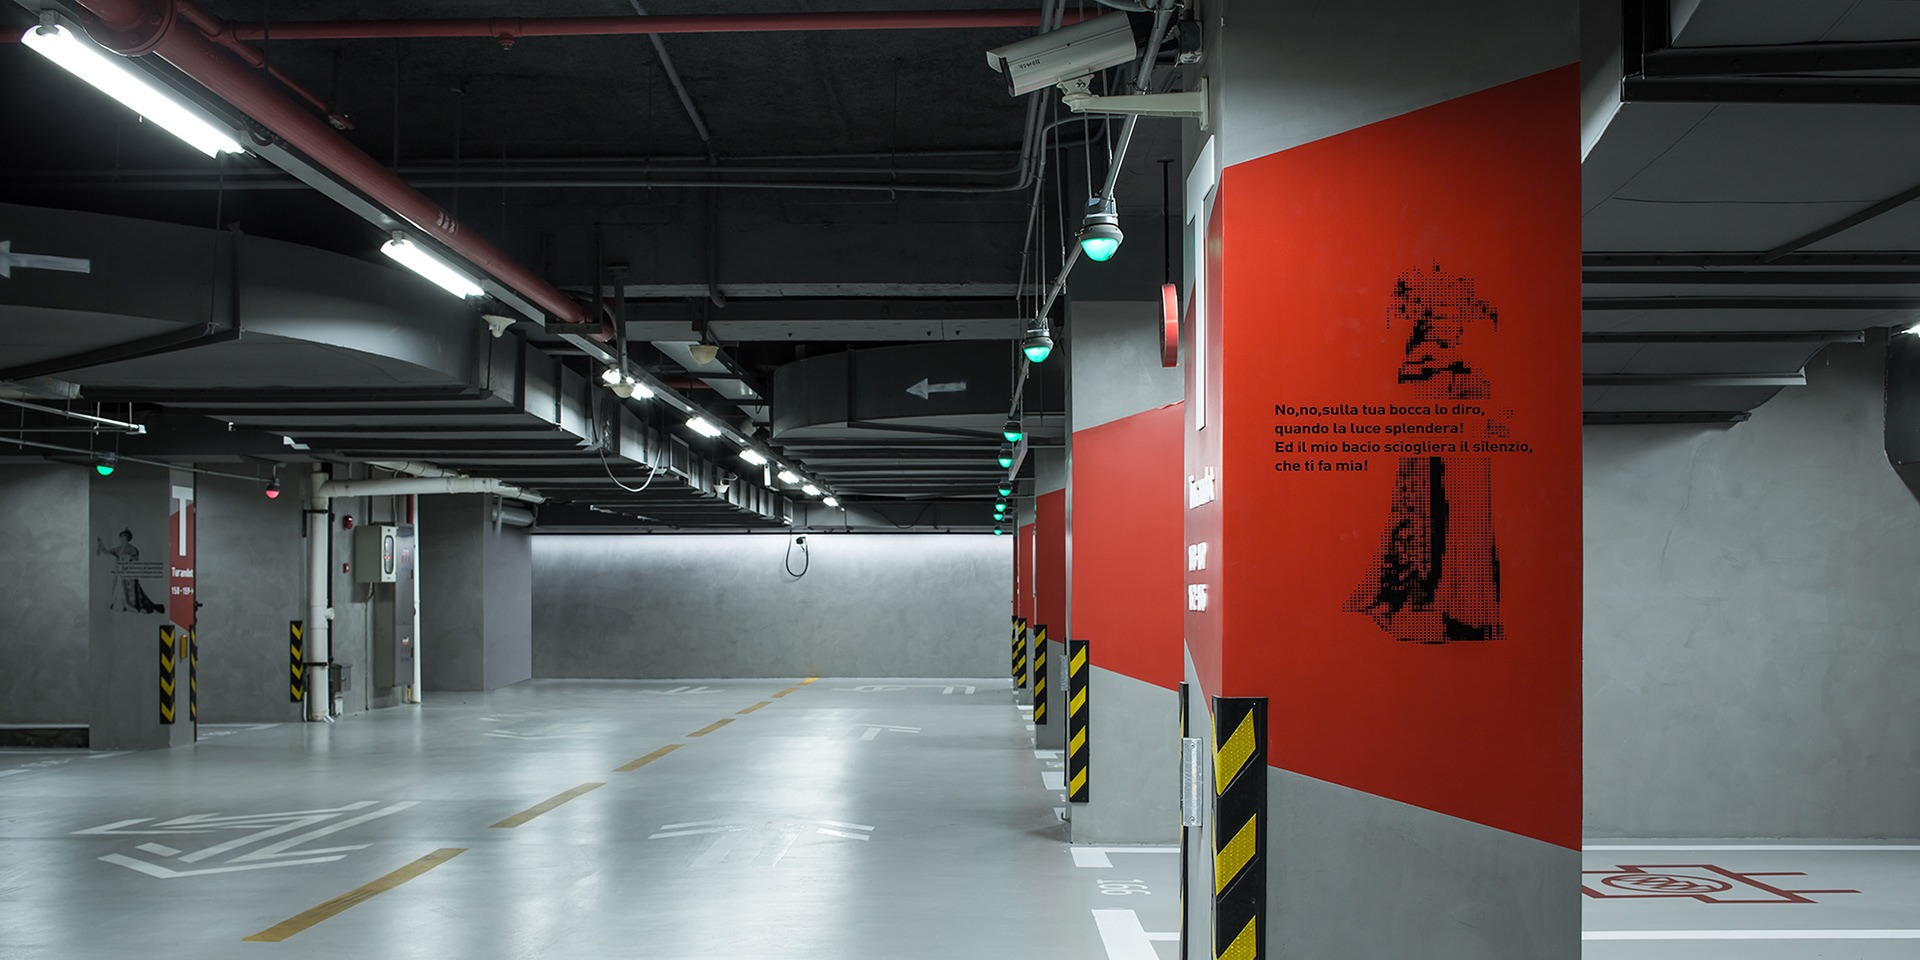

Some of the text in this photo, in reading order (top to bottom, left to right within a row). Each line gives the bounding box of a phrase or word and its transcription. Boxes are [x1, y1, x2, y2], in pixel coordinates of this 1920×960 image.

[1186, 134, 1215, 432] T
[1274, 403, 1485, 418] No,no,sulla tua bocca lo diro,
[1274, 422, 1464, 437] quando la luce splendera!
[1275, 440, 1534, 455] Ed il mio bacio sciogliera il silenzio,
[1274, 459, 1369, 472] che ti fa mia!
[171, 485, 194, 557] T
